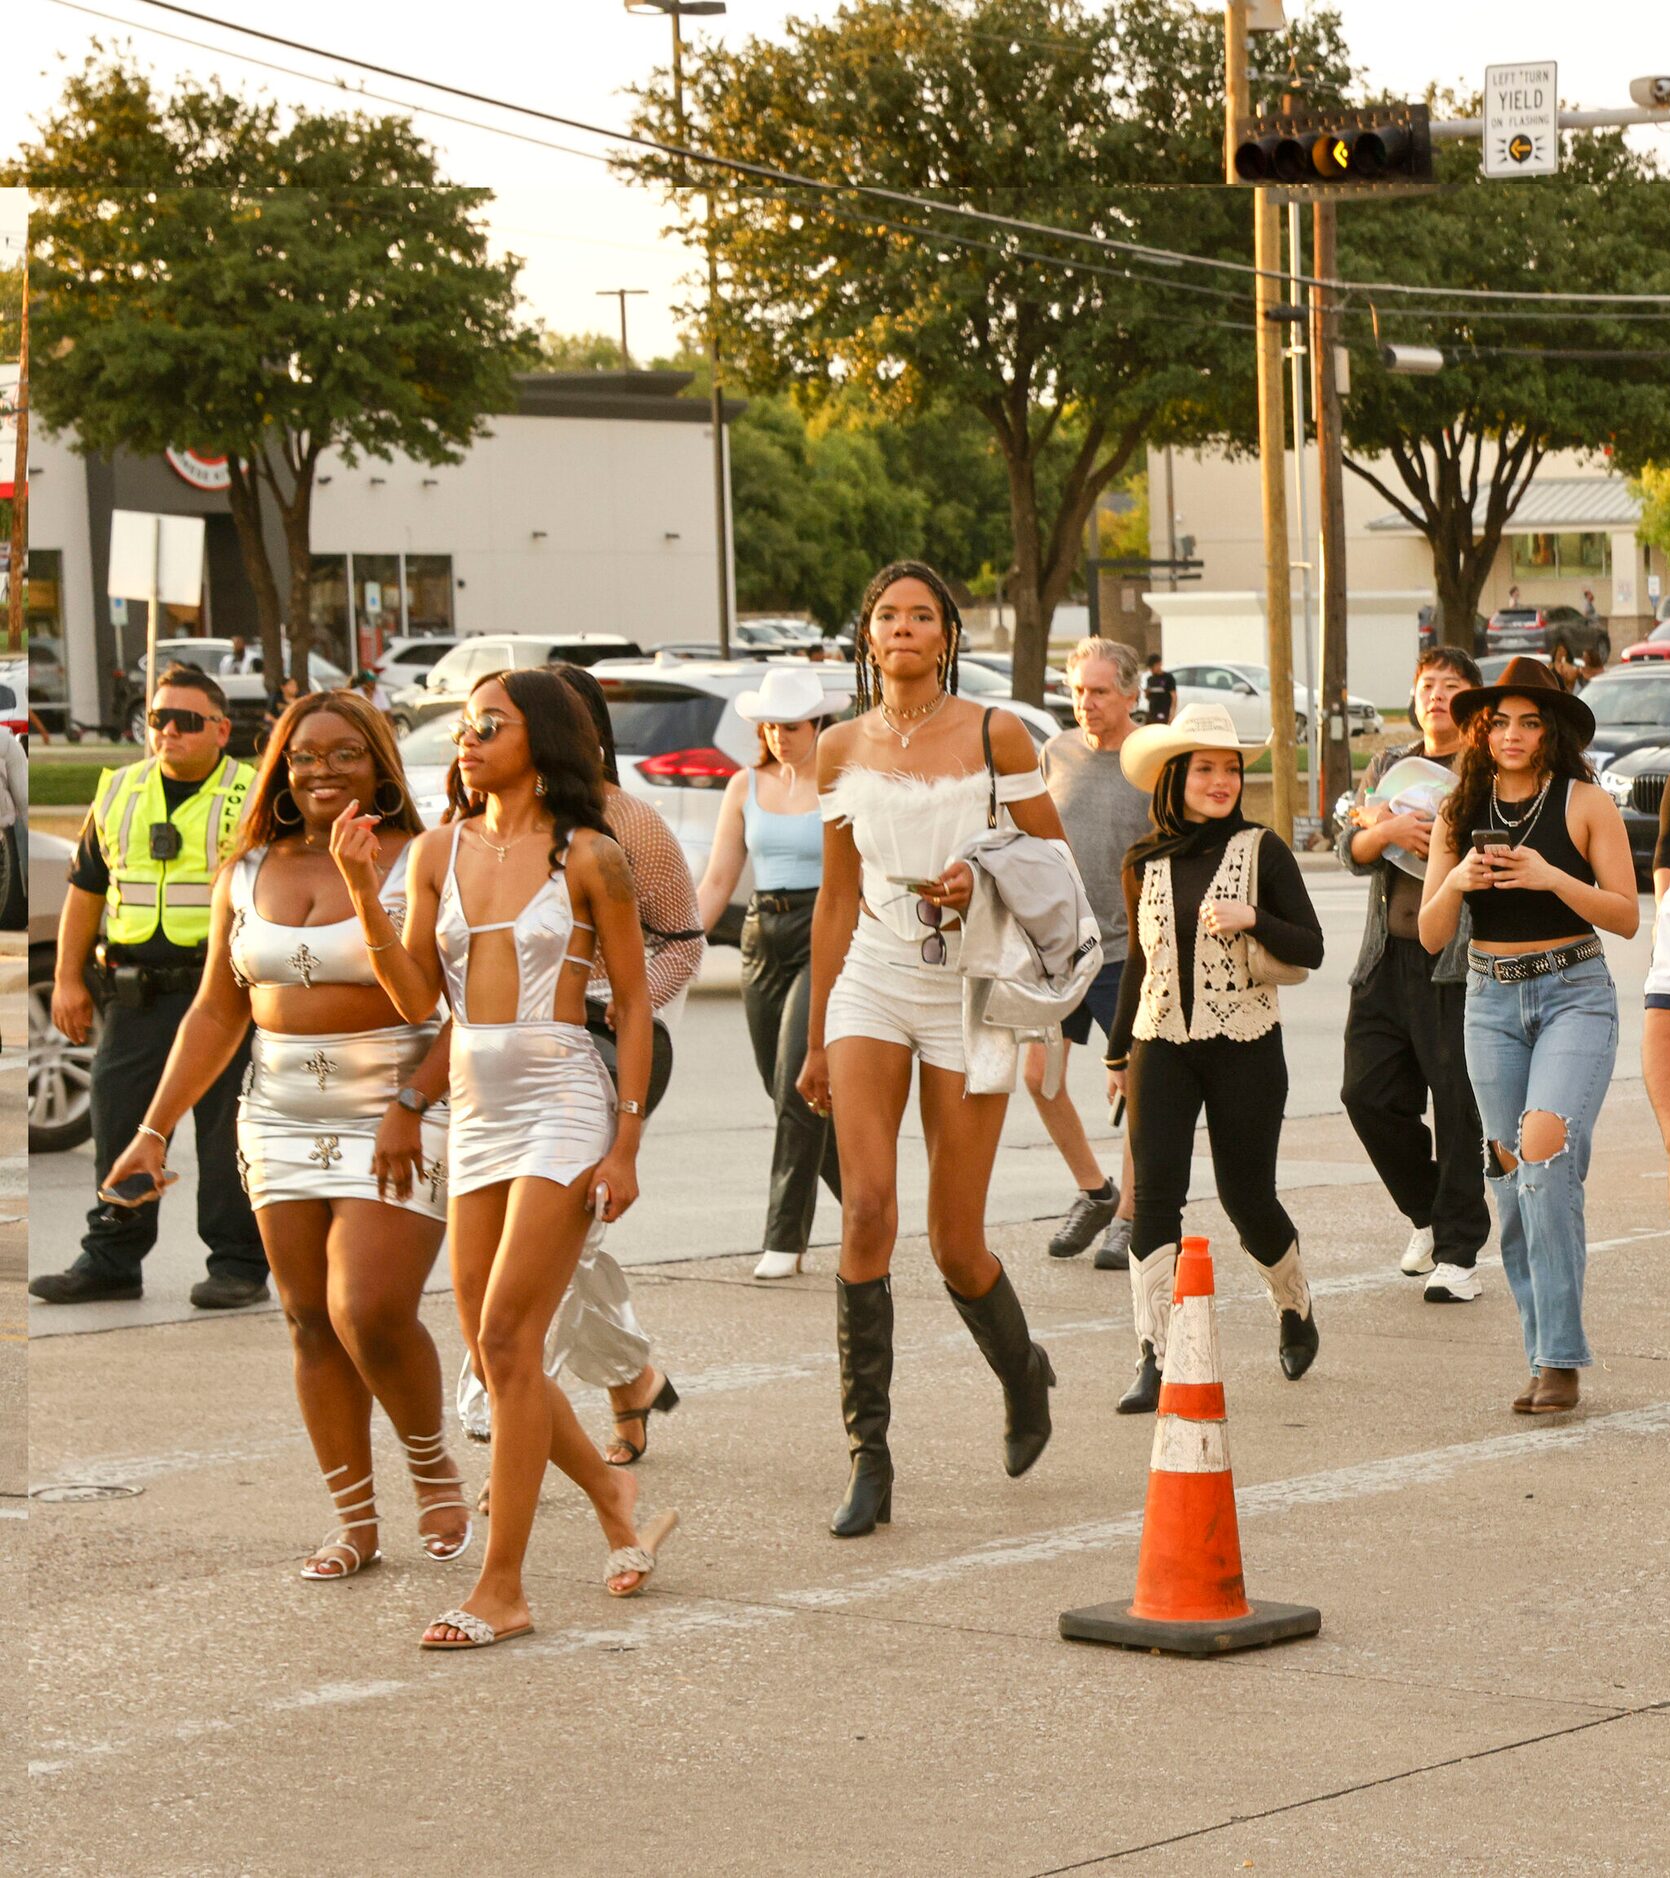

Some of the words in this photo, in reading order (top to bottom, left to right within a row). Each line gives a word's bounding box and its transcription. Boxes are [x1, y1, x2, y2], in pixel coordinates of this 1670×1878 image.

[1492, 71, 1516, 87] LEFT
[1522, 69, 1549, 84] TURN
[1499, 88, 1543, 111] YIELD
[1490, 117, 1504, 129] ON
[1508, 113, 1550, 128] FLASHING
